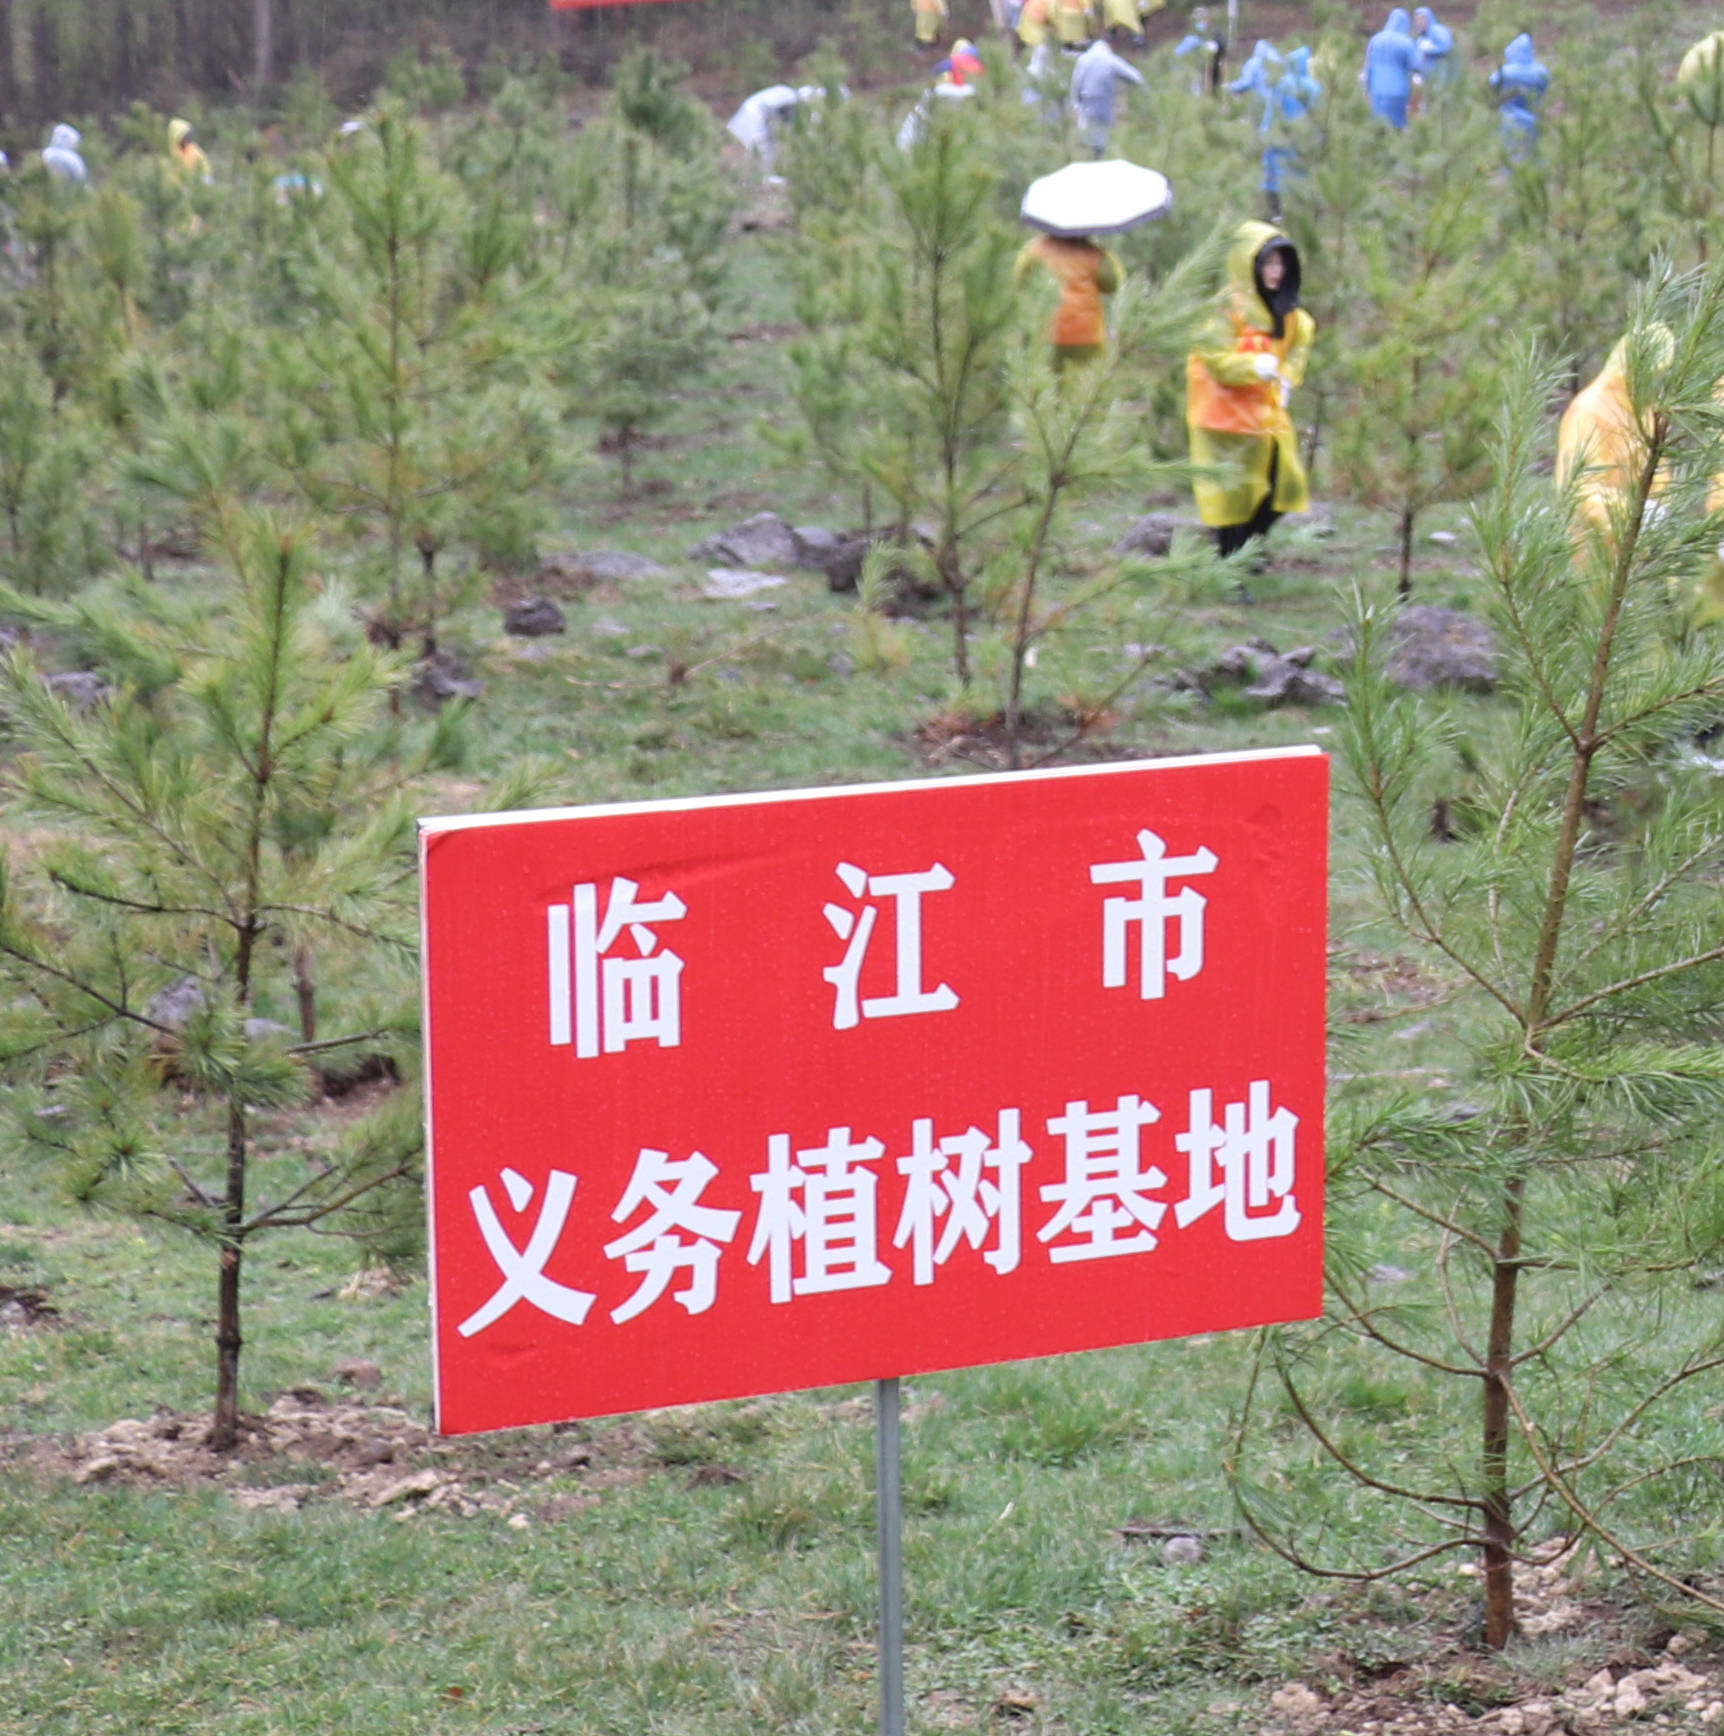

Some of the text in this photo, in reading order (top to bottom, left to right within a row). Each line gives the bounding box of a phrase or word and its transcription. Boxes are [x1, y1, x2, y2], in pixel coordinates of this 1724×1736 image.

[547, 829, 1219, 1059] 临江市
[458, 1080, 1302, 1337] 义务植树基地
